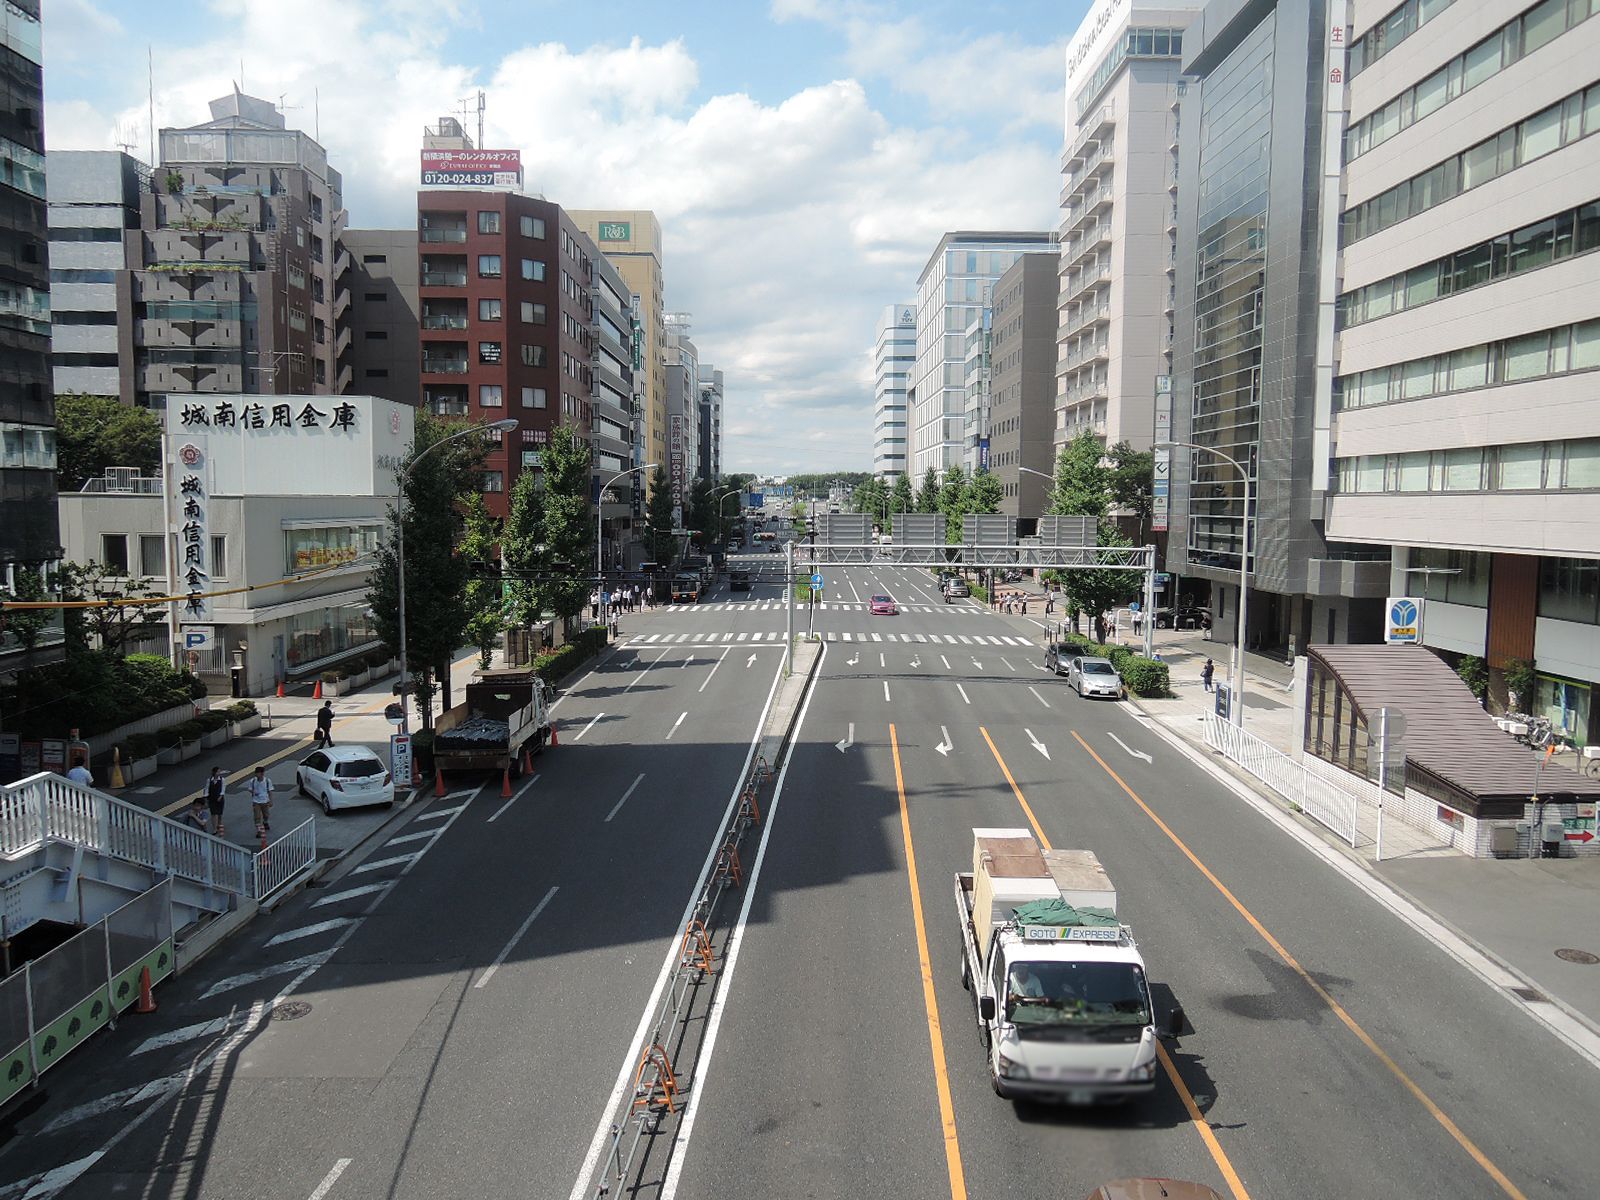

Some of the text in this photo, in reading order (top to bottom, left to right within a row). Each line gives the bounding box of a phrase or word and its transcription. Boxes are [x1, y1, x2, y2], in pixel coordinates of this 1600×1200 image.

[1330, 27, 1343, 84] 生命
[424, 174, 493, 184] 0120-024-837
[604, 225, 625, 239] R&B
[180, 401, 359, 432] 城南信用金庫
[180, 475, 207, 615] 城南信用金庫
[186, 633, 206, 648] P
[1073, 929, 1116, 939] EXPRESS
